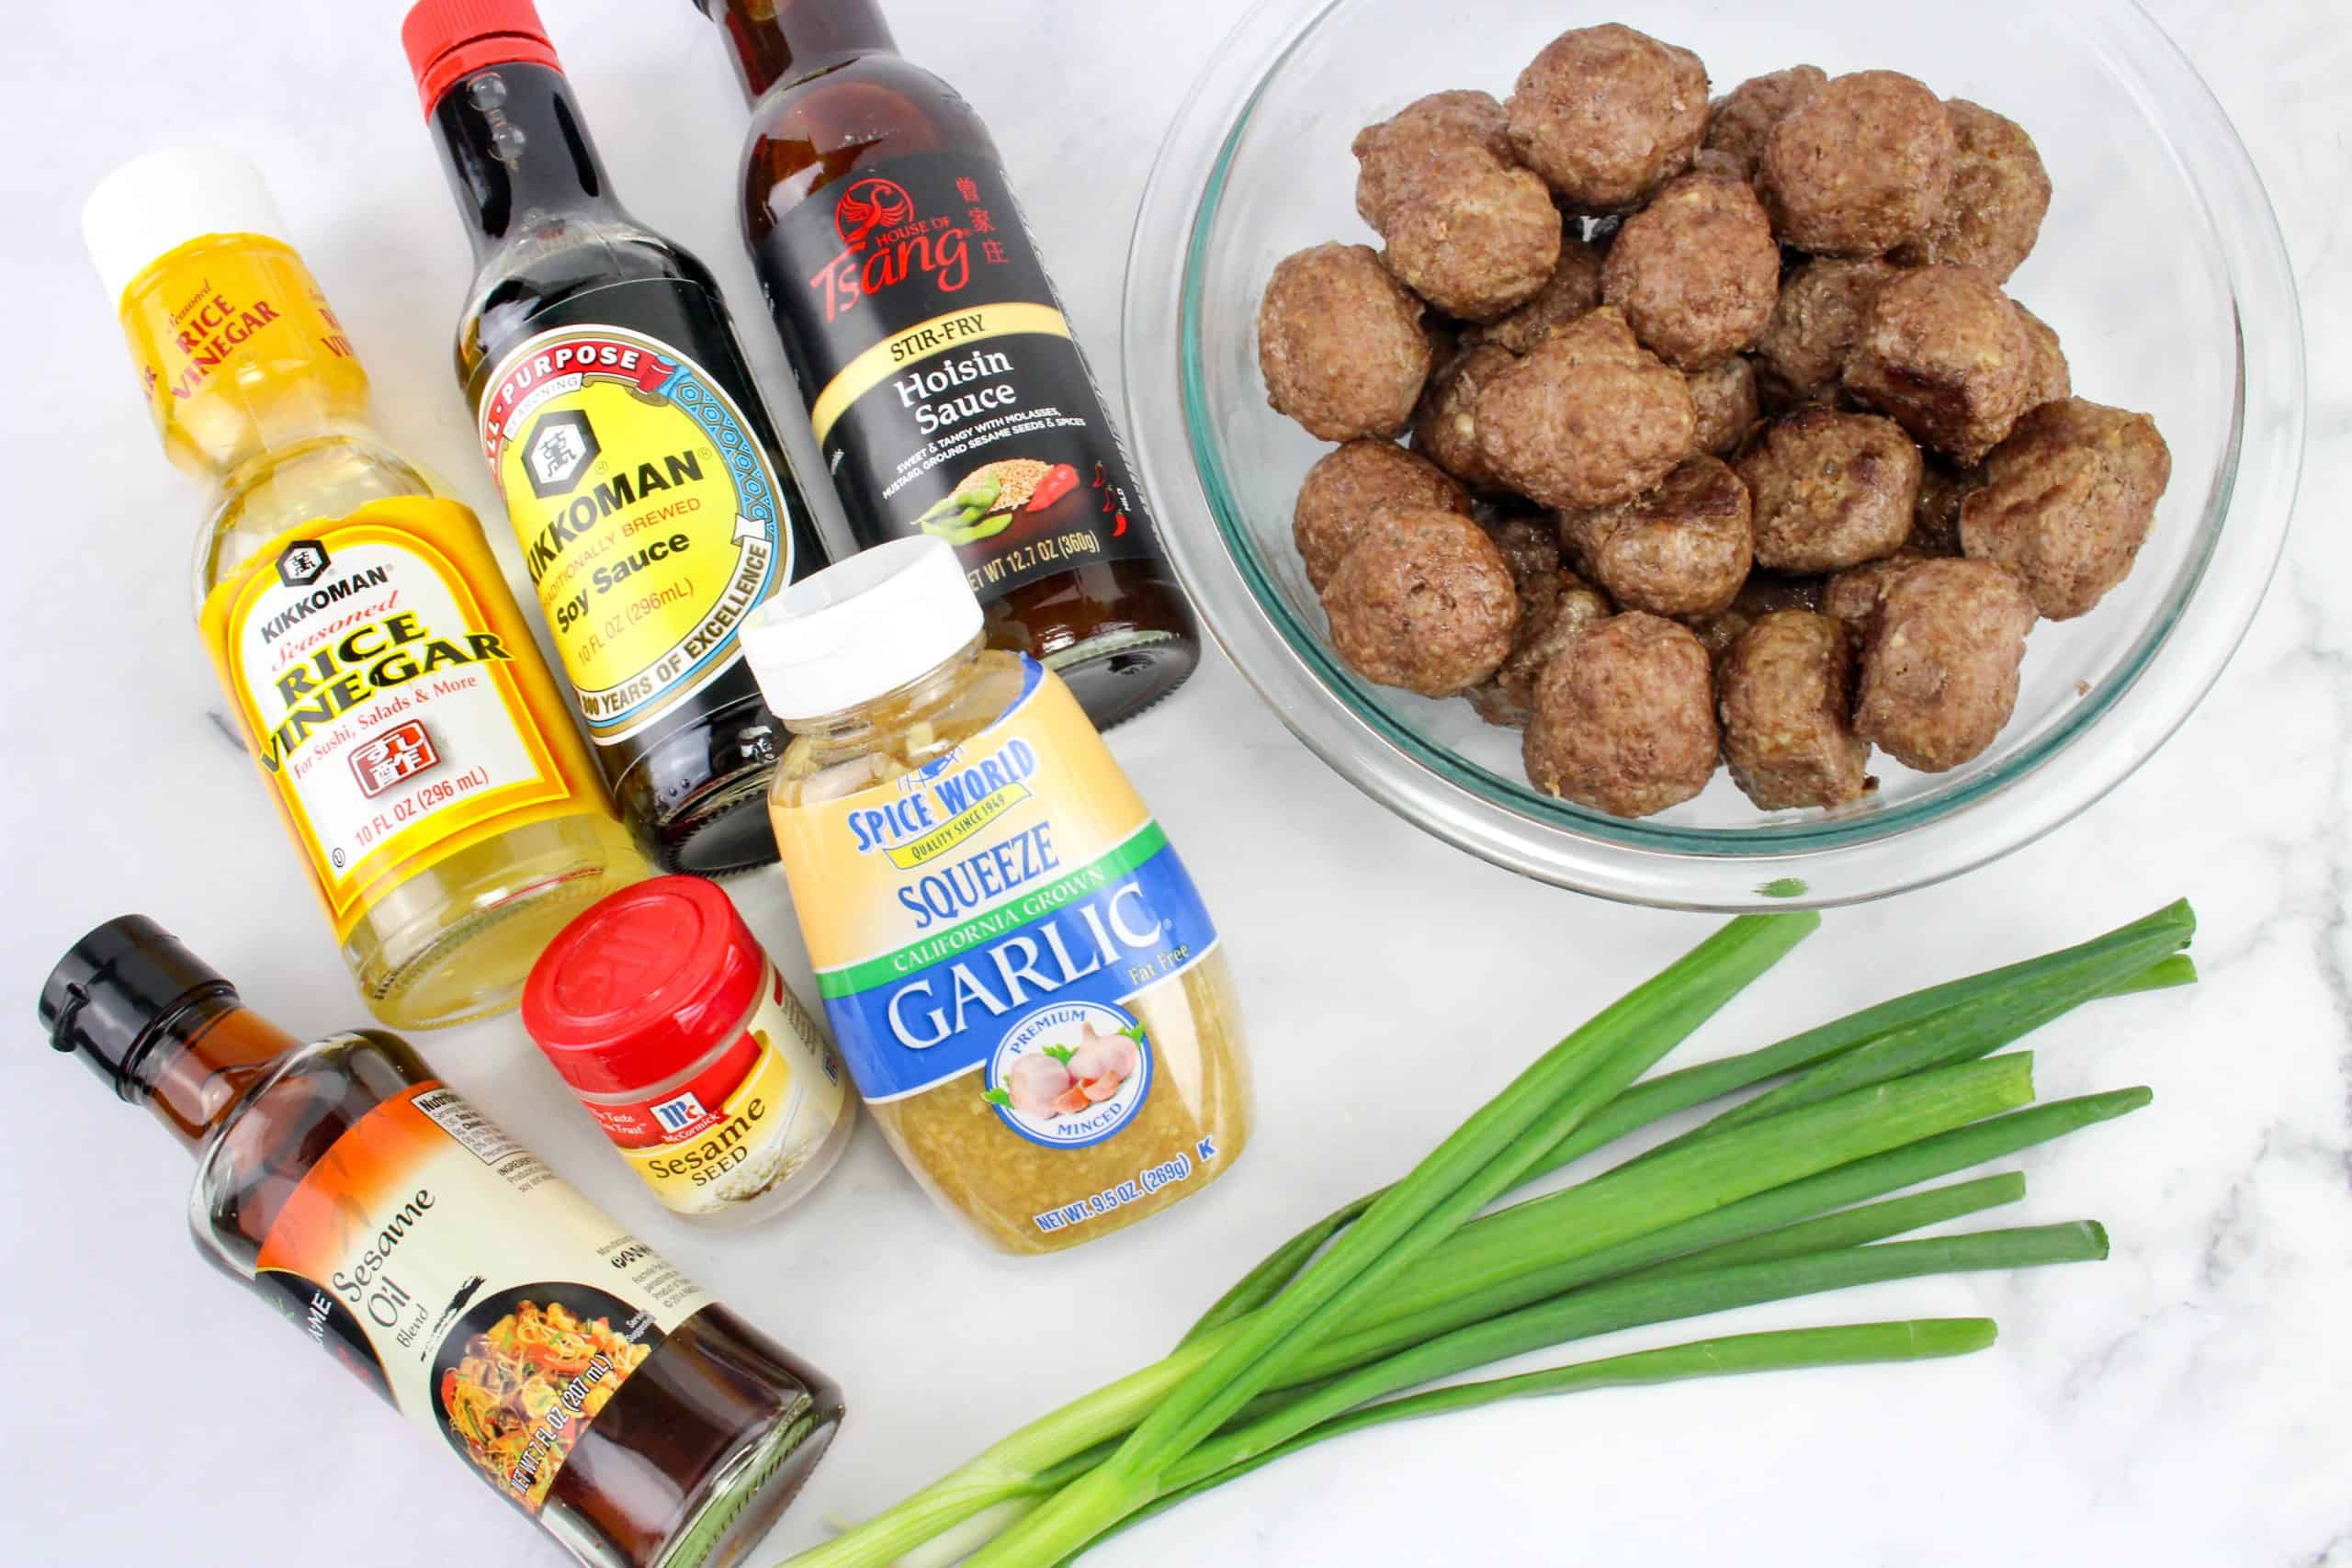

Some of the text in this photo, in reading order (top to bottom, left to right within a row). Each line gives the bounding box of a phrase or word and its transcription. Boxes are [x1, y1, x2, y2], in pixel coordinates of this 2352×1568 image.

[875, 216, 951, 246] HOUSE OF
[809, 228, 970, 323] Tsang
[172, 300, 280, 398] VINEGAR
[176, 294, 235, 355] RICE
[891, 314, 985, 362] STIR-FRY
[893, 351, 1014, 408] Hoisin
[915, 384, 1016, 434] Sauce
[882, 468, 924, 500] MUSTARD,
[922, 443, 967, 469] GROUND
[967, 428, 1012, 449] SESAME
[1012, 420, 1046, 434] SEEDS
[1046, 417, 1056, 428] &
[897, 407, 1062, 474] SWEET & TANGY WITH MOLASSES,
[622, 498, 701, 538] BREWED
[557, 533, 690, 633] Soy Sauce
[967, 529, 1101, 592] ET WT 12.7 OZ (360g)
[261, 566, 389, 644] KIKKOMAN
[272, 590, 399, 671] Seasoned
[578, 578, 694, 666] 10 FL OZ (296mL)
[602, 677, 653, 713] YEARS
[656, 653, 684, 682] OF
[684, 544, 767, 660] EXCELLENCE
[276, 613, 427, 709] RICE
[261, 633, 514, 773] VINEGAR
[293, 675, 478, 779] For Sushi, Salads & More
[355, 765, 491, 847] 10 FL OZ (296 mL)
[847, 739, 1035, 852] SPICE WORLD
[910, 794, 1006, 861] QUALITY SINCE 1949
[898, 821, 1059, 928] SQUEEZE
[893, 868, 1105, 972] CALIFORNIA GROWN
[888, 881, 1162, 1050] GARLIC
[1128, 942, 1189, 985] Fat Free
[1011, 1009, 1086, 1055] PREMIUM
[649, 1098, 764, 1179] Sesame
[662, 1113, 720, 1142] McCormick
[1057, 1102, 1123, 1136] MINCED
[1198, 1138, 1216, 1160] K
[692, 1145, 747, 1186] SEED
[1036, 1155, 1191, 1231] NET WT. 9.5 OZ. (269g)
[333, 1190, 435, 1303] Sesame
[368, 1275, 412, 1328] Oil
[396, 1303, 428, 1348] Blend
[560, 1376, 591, 1412] (207
[586, 1353, 614, 1383] mL)
[529, 1440, 546, 1456] 7
[535, 1427, 557, 1448] FL
[546, 1405, 570, 1431] OZ
[516, 1450, 541, 1476] WT
